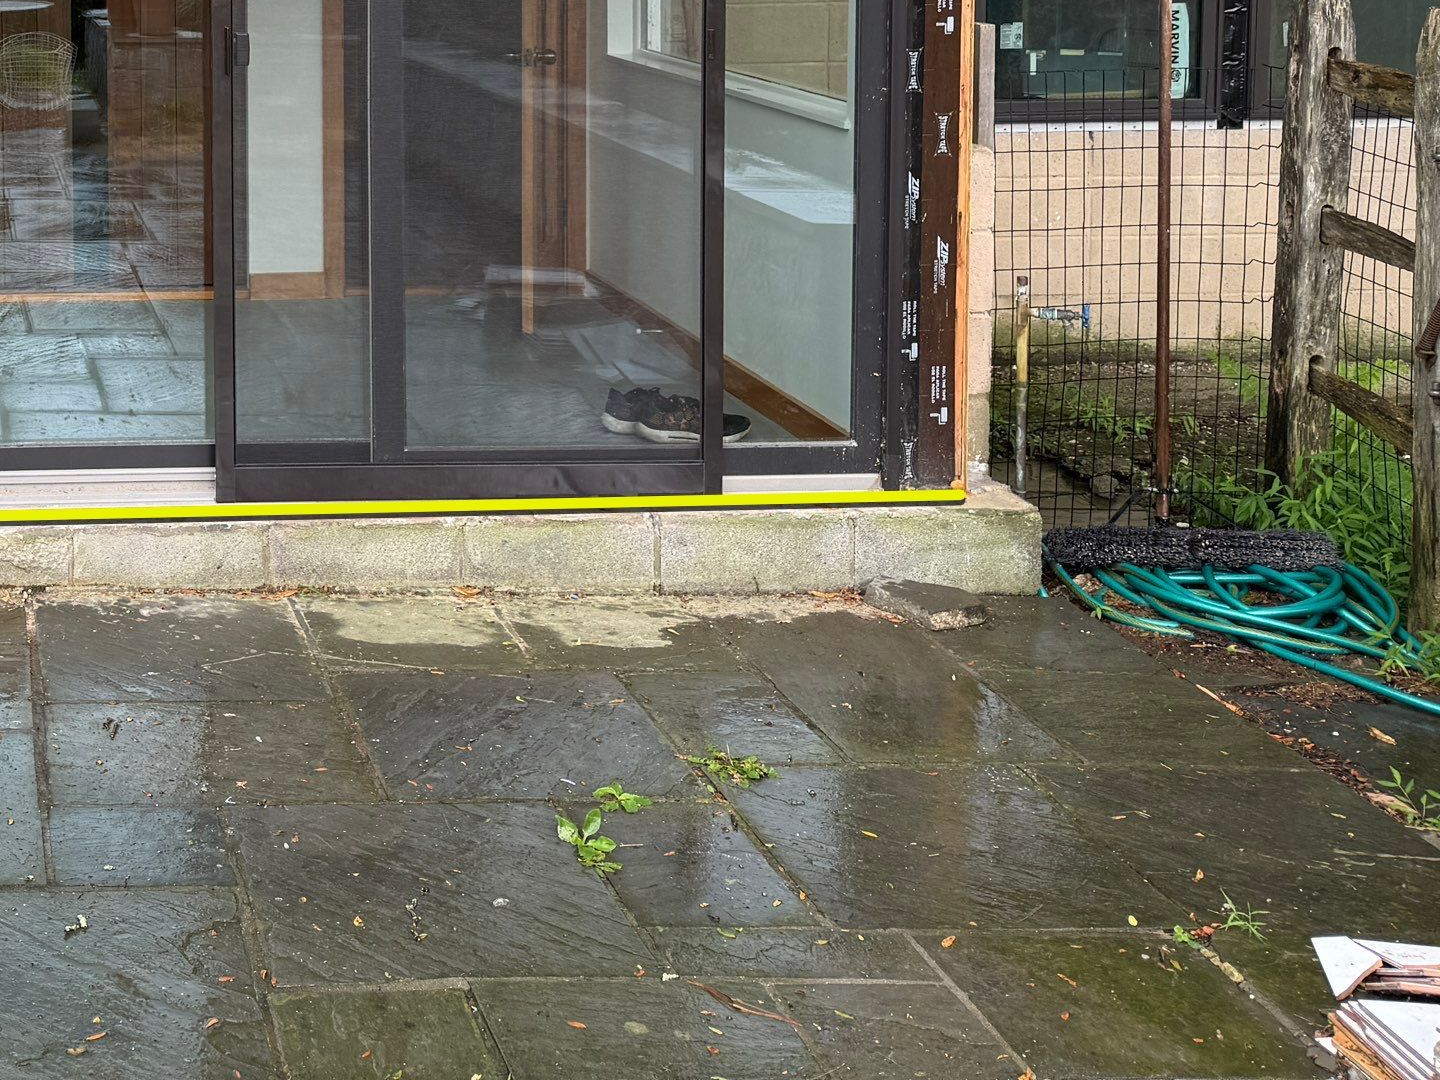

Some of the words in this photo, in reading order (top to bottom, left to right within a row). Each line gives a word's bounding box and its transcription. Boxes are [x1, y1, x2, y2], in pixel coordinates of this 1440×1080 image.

[1171, 10, 1179, 64] MARVIN
[909, 76, 918, 89] TAPE
[939, 140, 948, 153] TAPE
